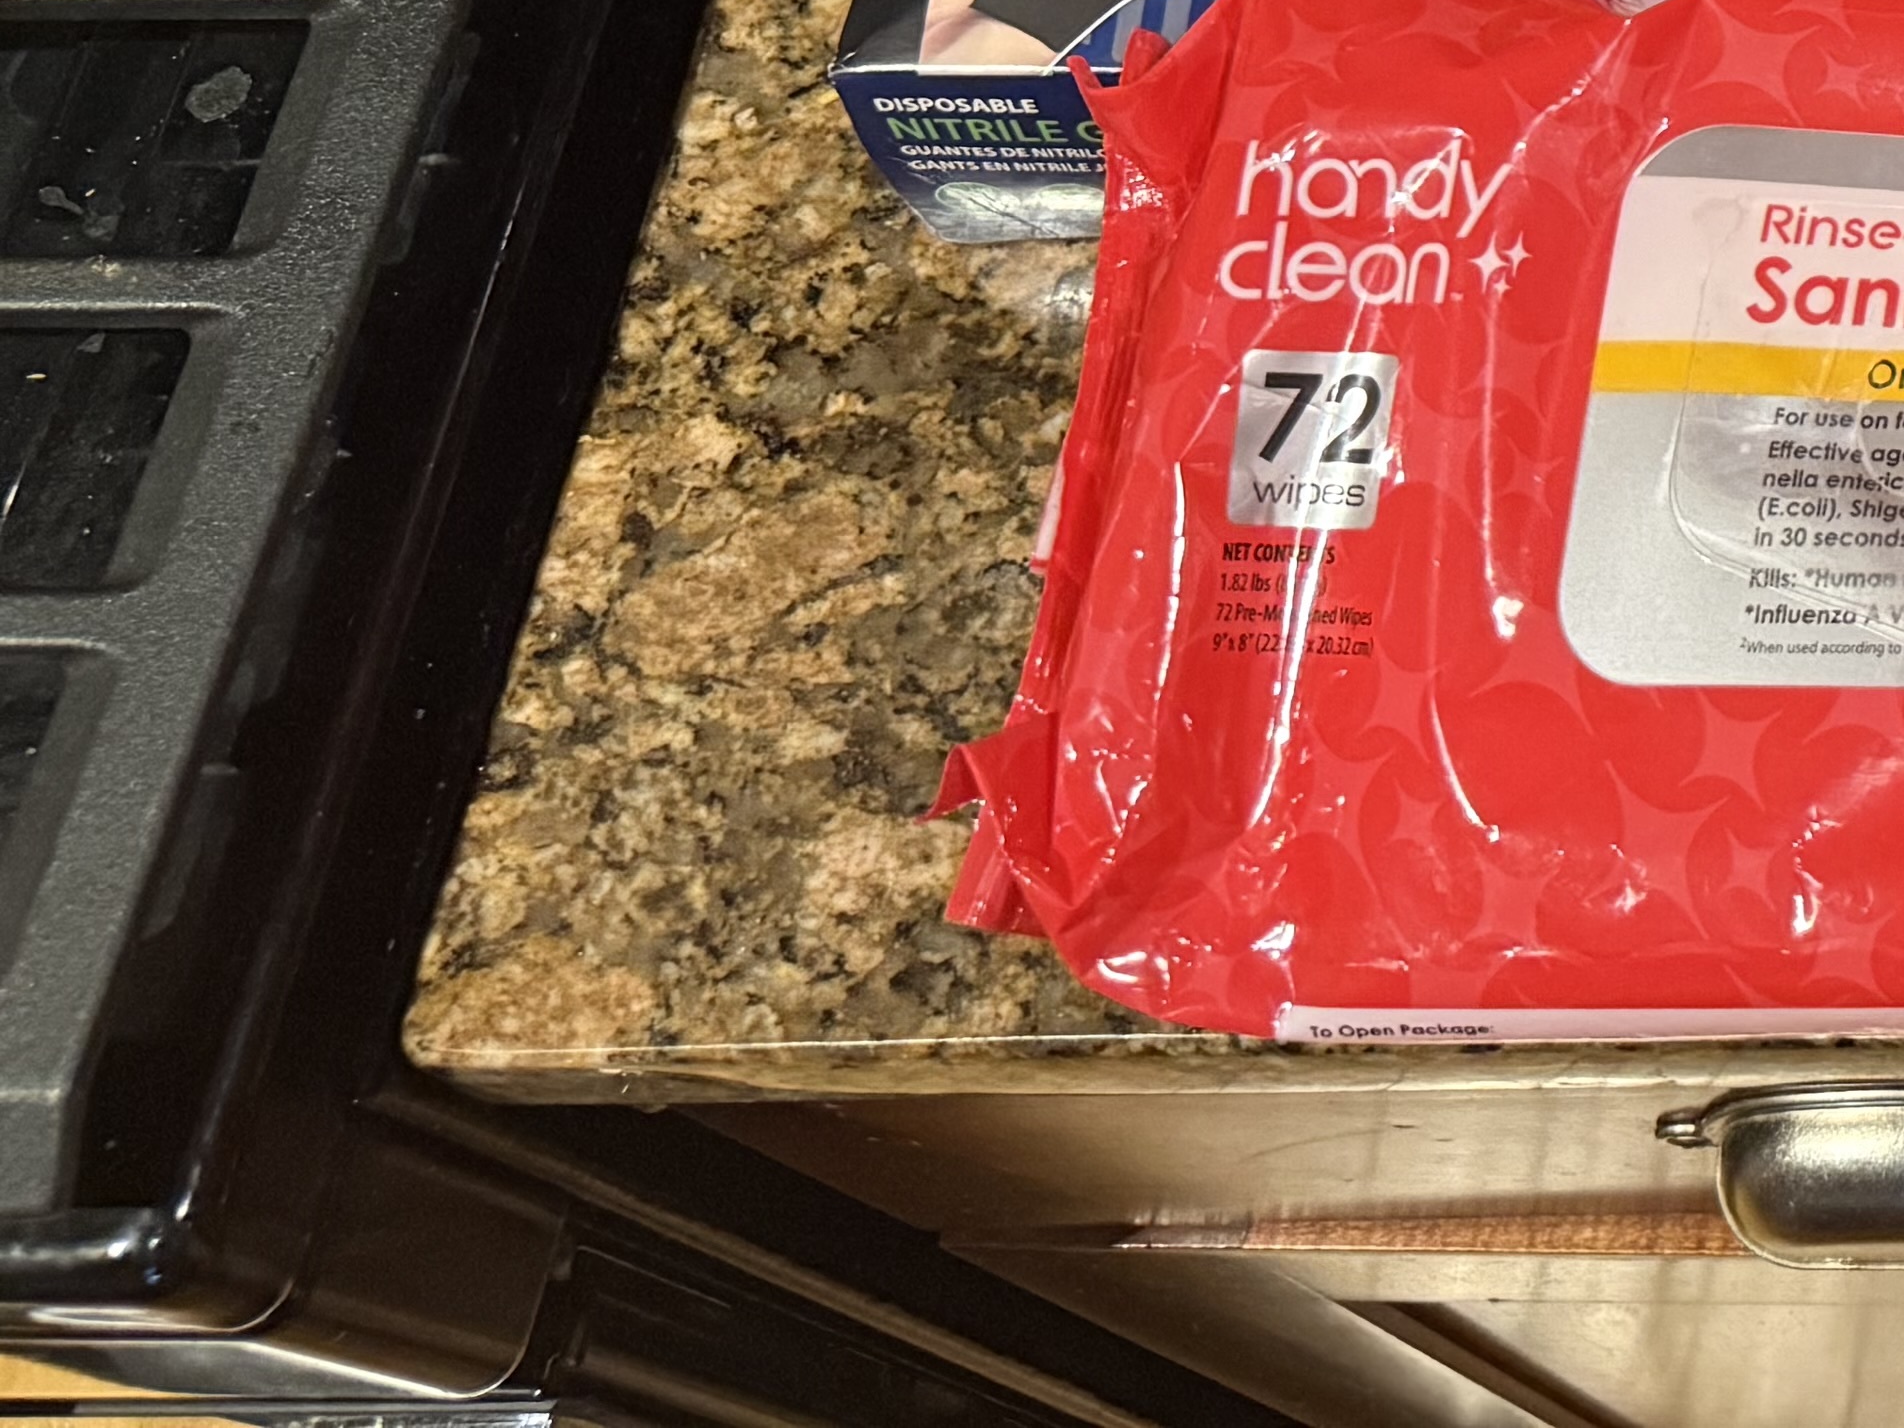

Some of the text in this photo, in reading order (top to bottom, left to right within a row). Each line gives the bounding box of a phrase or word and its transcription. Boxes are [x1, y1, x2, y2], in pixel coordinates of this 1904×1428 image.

[872, 97, 1040, 114] DISPOSABLE
[886, 117, 1069, 142] NITRILE
[1236, 138, 1514, 238] handy
[1219, 220, 1450, 305] clean
[1258, 371, 1382, 465] 72
[1253, 473, 1366, 512] wipes
[1310, 1023, 1494, 1039] To Open Package:
